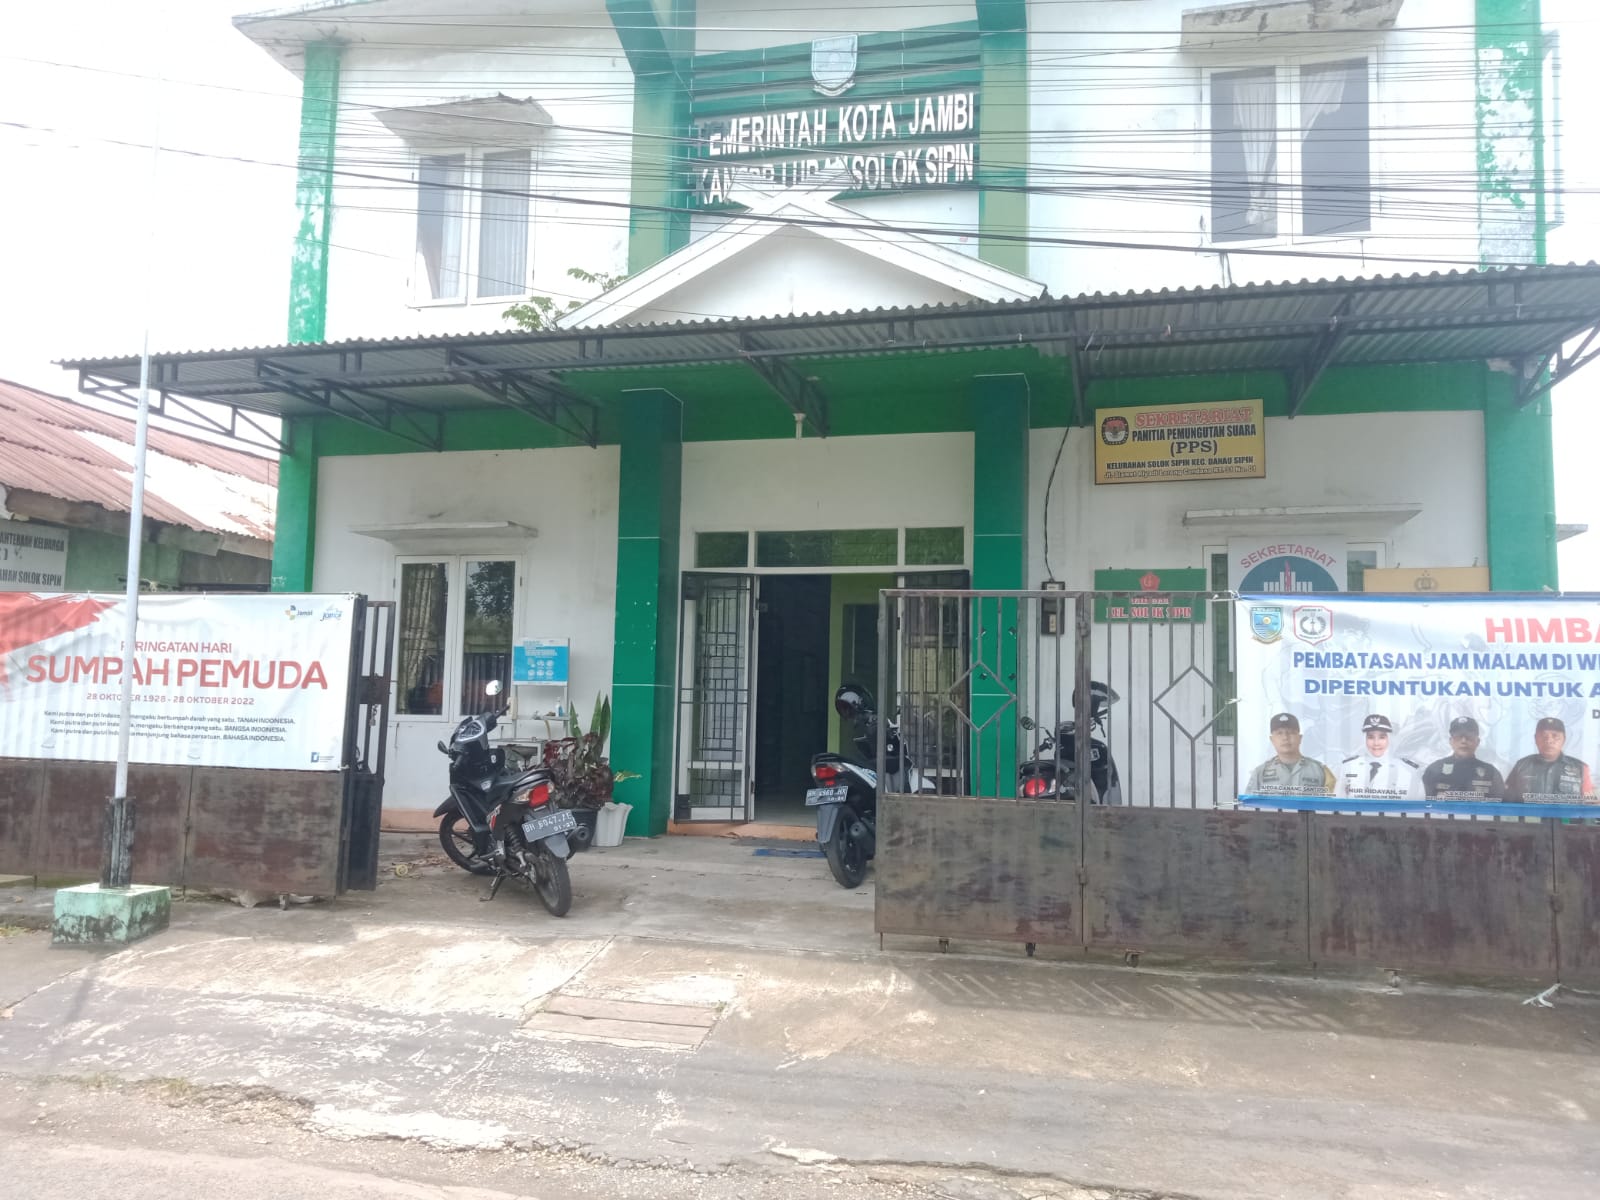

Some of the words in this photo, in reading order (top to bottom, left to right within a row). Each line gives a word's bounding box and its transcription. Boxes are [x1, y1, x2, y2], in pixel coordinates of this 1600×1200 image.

[838, 102, 897, 142] KOTA
[908, 92, 974, 135] JAMBI
[852, 148, 920, 190] SOLOK
[925, 143, 974, 184] SIPIN
[1136, 408, 1253, 428] SEKRETARIAT
[1132, 430, 1164, 442] PANITIA
[1167, 426, 1224, 440] PEMUNGUTAN
[1227, 424, 1256, 437] SUARA
[1170, 440, 1218, 457] (PPS)
[1106, 461, 1146, 470] KELURAHAN
[1148, 460, 1170, 468] SOLOK
[1171, 459, 1190, 467] SIPIN
[1191, 458, 1206, 466] KEC.
[1208, 458, 1232, 466] DANAU
[1234, 456, 1254, 464] SIPIN
[1240, 544, 1336, 568] SEKRETARIAT
[18, 571, 40, 584] SOLOK
[42, 574, 62, 586] SIPIN
[1485, 618, 1600, 644] HIMB
[201, 642, 232, 654] HARI
[1294, 652, 1422, 669] PEMBATASAN
[1426, 653, 1468, 670] JAM
[1474, 654, 1548, 670] MALAM
[1552, 654, 1573, 670] DI
[26, 654, 170, 686] SUMPAH
[177, 660, 328, 690] PEMUDA
[1304, 679, 1491, 696] DIPERUNTUKAN
[1496, 681, 1584, 698] UNTUK
[187, 696, 229, 704] OKTOBER
[231, 697, 254, 705] 2022
